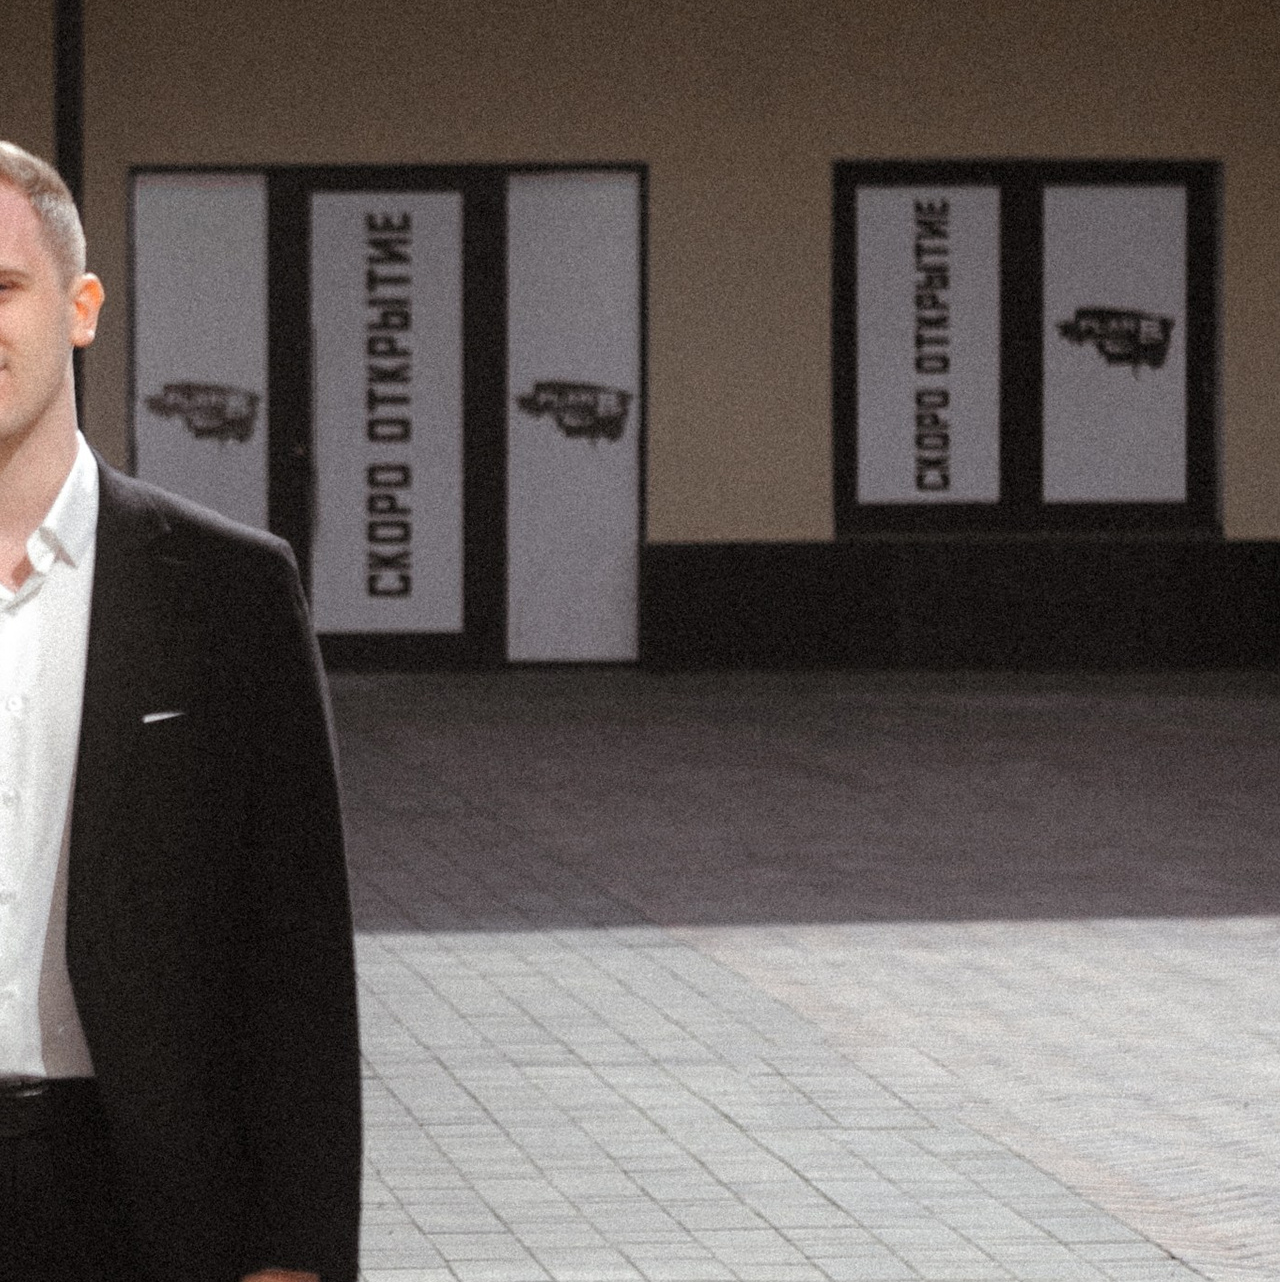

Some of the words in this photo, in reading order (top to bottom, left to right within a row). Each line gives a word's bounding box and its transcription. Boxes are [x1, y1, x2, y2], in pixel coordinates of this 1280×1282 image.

[365, 211, 413, 444] ОТКРЫТИЕ
[914, 197, 951, 376] ОТКРЫТИЕ
[914, 387, 951, 492] СКОРО
[365, 462, 413, 599] СКОРО
